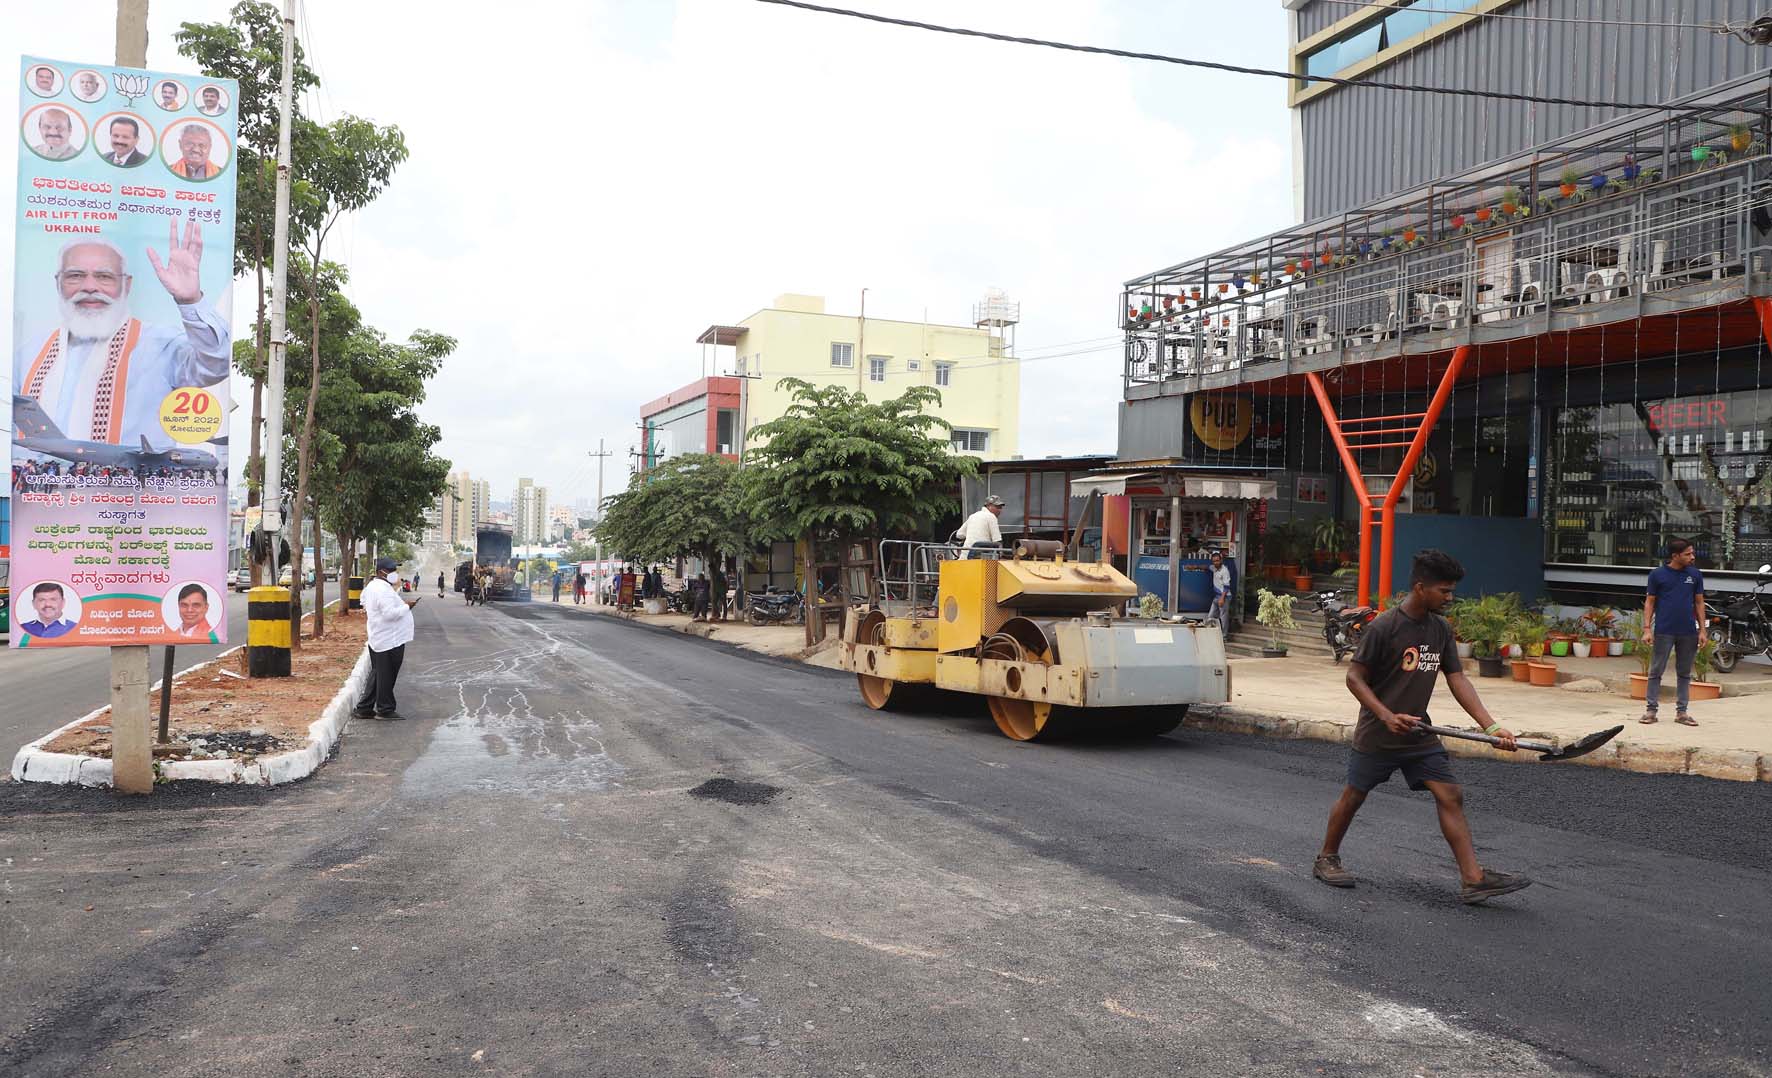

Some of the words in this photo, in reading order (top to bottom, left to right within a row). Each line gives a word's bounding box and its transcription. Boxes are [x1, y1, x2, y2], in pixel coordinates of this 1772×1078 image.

[32, 176, 112, 194] ಭಾರತೀಯ
[120, 183, 167, 200] ಜನತಾ
[174, 189, 217, 203] ಪಾರ್ಟಿ
[25, 209, 49, 219] AIR
[52, 210, 80, 220] LIFT
[83, 211, 118, 221] FROM
[27, 193, 112, 210] ಯಶವಂತಪುರ
[117, 201, 182, 217] ವಿಧಾನಸಭಾ
[188, 207, 222, 225] ಕ್ಷೇತ್ರಕ್ಕೆ
[44, 224, 101, 234] UKRAINE
[173, 392, 209, 414] 20
[193, 416, 221, 424] 2022
[1202, 400, 1238, 428] PUB
[1649, 399, 1728, 430] BEER
[26, 473, 109, 490] ಆಗಮಿಸುತ್ತಿರುವ
[113, 475, 142, 492] ನಮ್ಮ
[179, 477, 216, 491] ಪ್ರಧಾನಿ
[70, 492, 86, 507] ಶ್ರೀ
[91, 492, 135, 506] ನರೇಂದ್ರ
[140, 493, 176, 505] ಮೋದಿ
[98, 509, 147, 524] ಸುಸ್ವಾಗತ
[148, 525, 208, 537] ಭಾರತೀಯ
[73, 554, 112, 566] ಮೋದಿ
[70, 570, 170, 591] ಧನ್ಯವಾದಗಳು
